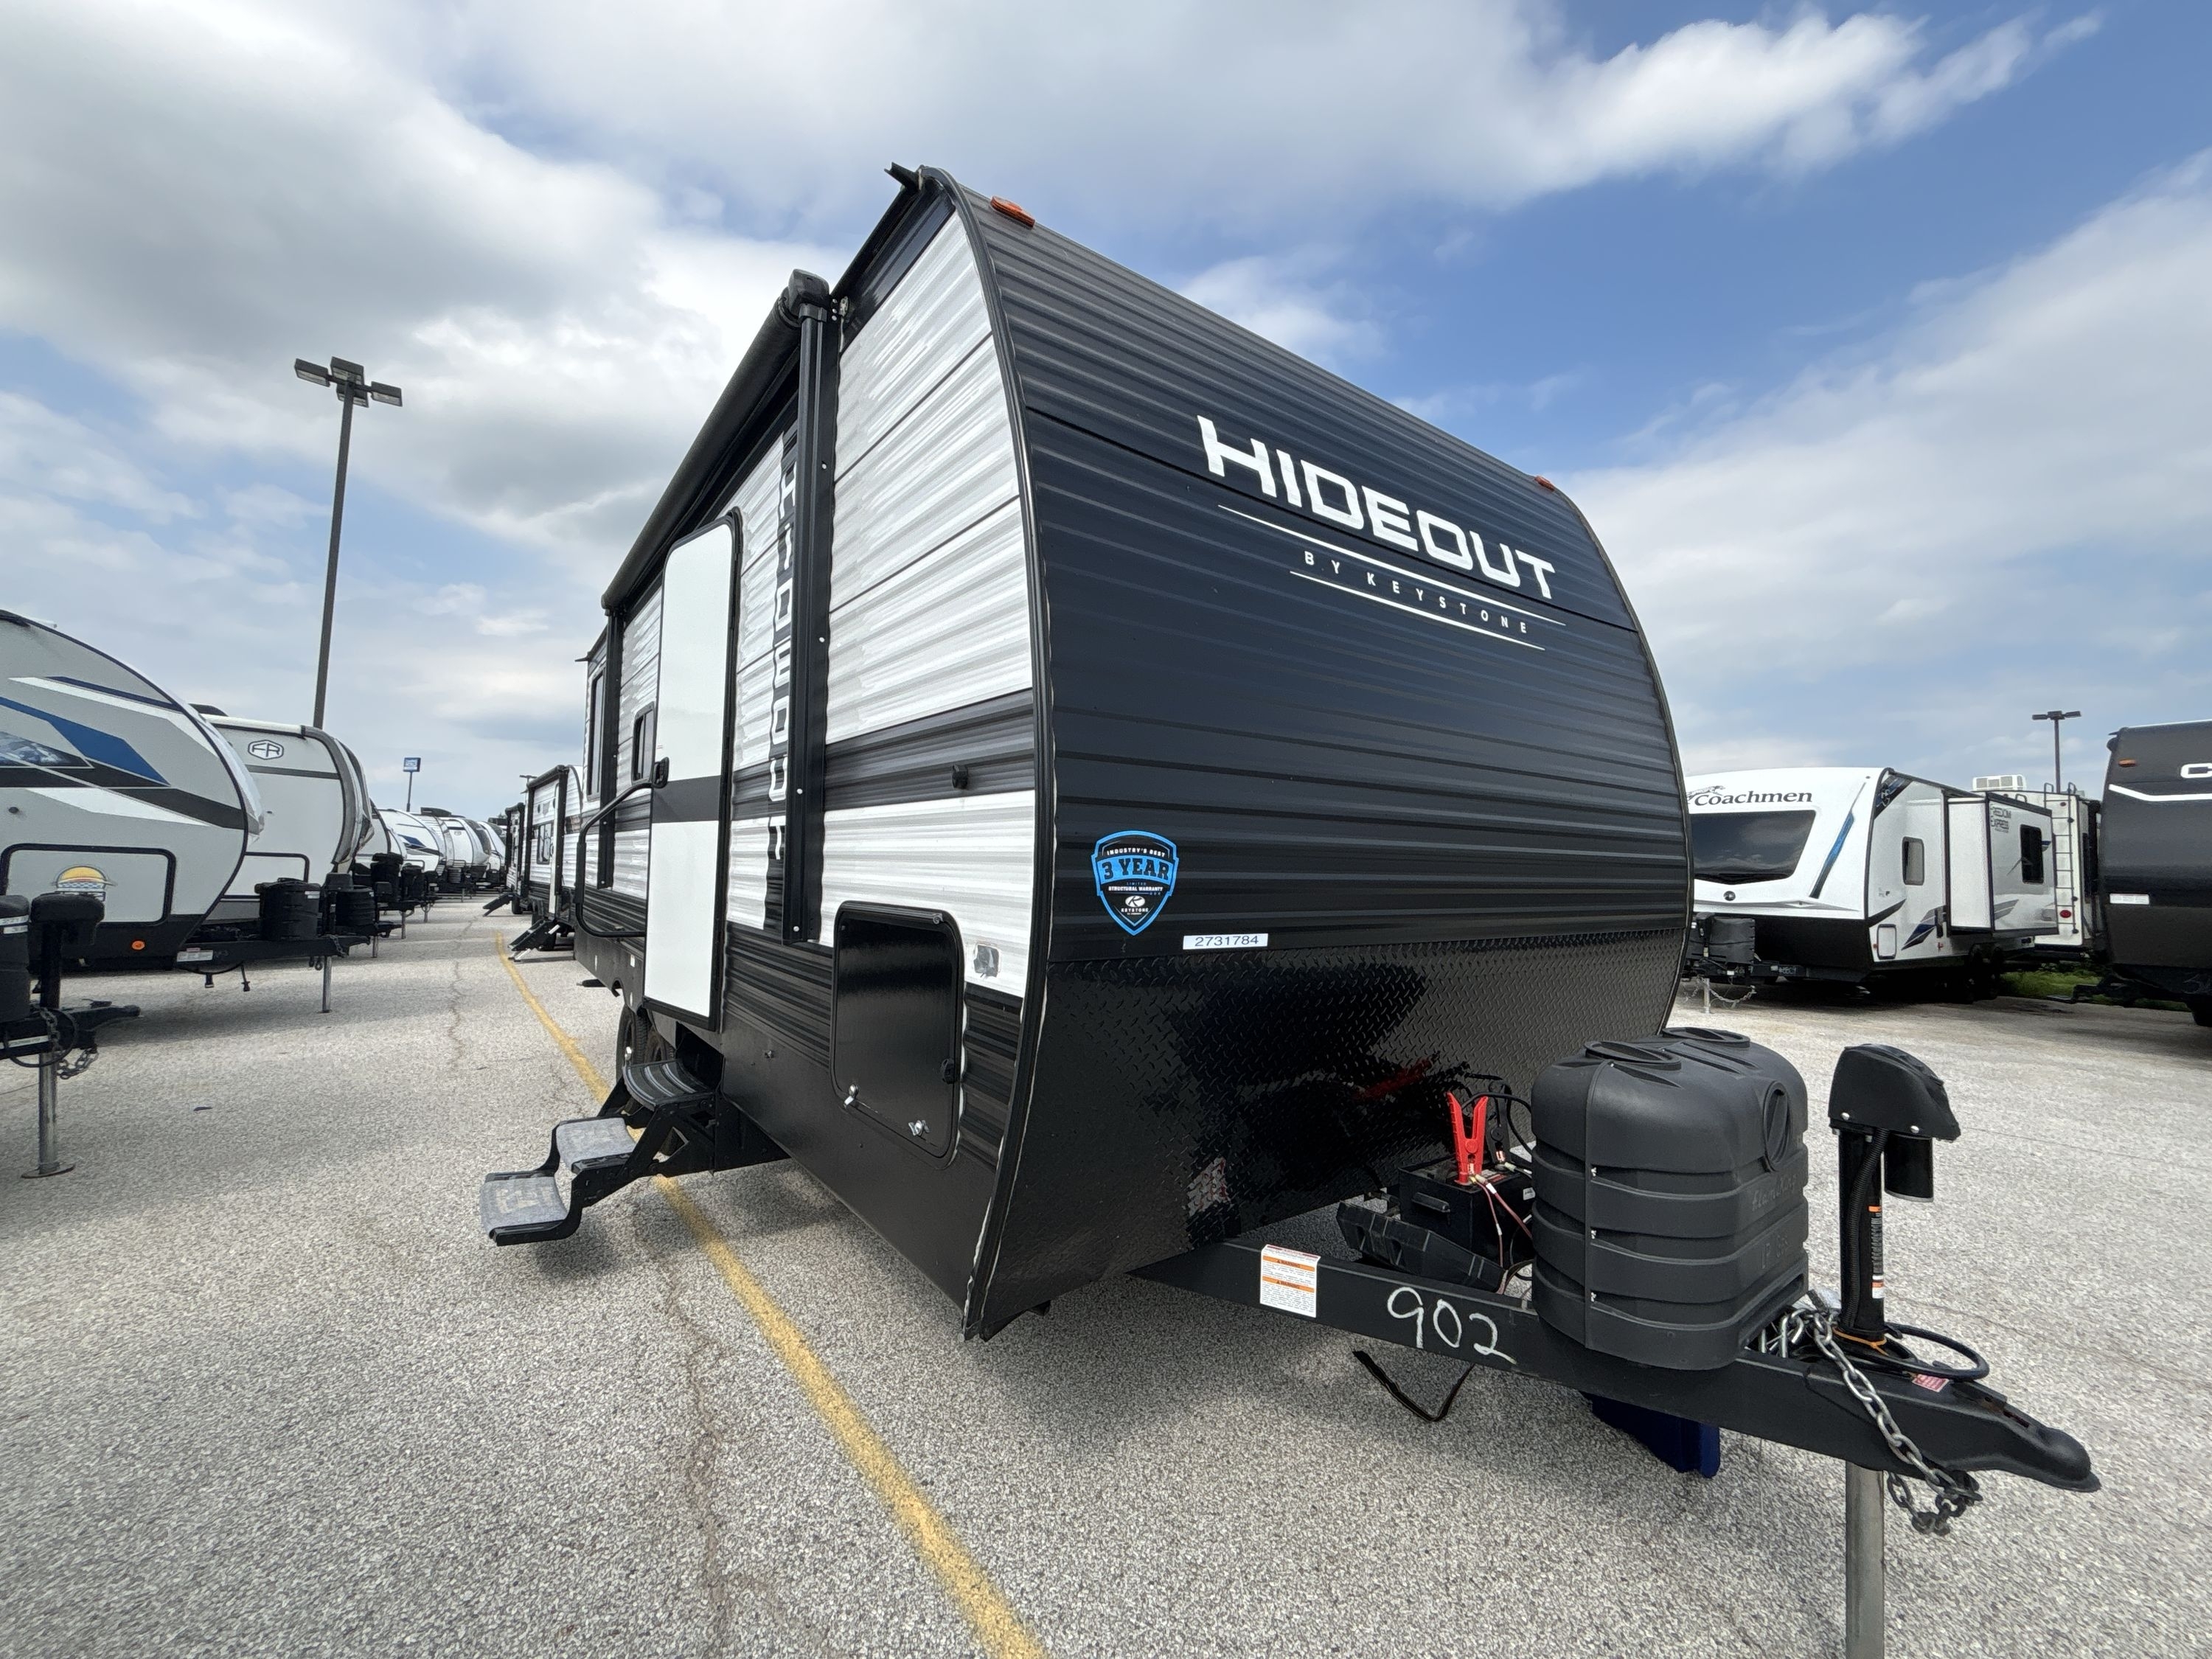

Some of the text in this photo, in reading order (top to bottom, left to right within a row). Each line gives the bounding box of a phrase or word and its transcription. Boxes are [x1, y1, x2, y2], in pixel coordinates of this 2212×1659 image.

[1197, 415, 1556, 599] HIDEOUT
[1304, 551, 1528, 634] BY KEYSTONE
[1694, 790, 1813, 807] Coachmen
[1107, 847, 1147, 855] INDUSTRY'S
[1102, 858, 1169, 880] 3 YEAR
[1194, 935, 1259, 947] 2731784
[1387, 1287, 1517, 1364] 902
